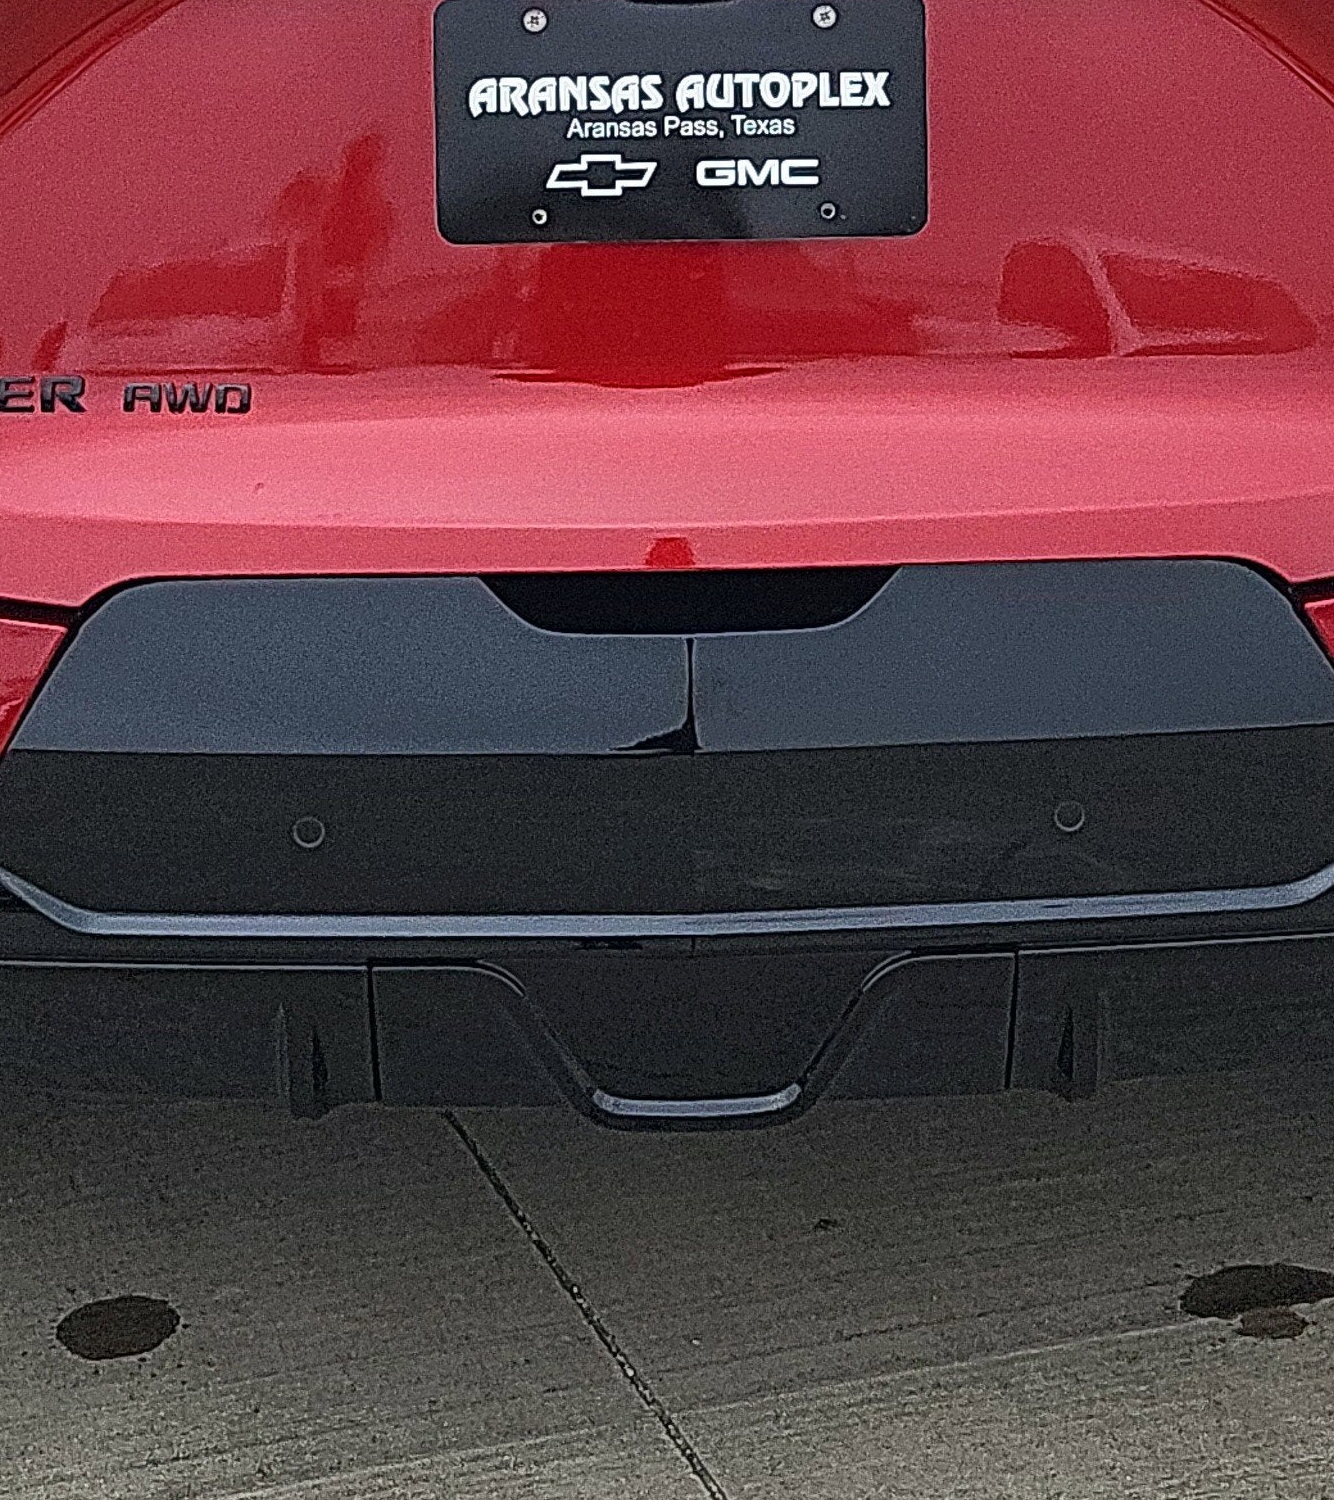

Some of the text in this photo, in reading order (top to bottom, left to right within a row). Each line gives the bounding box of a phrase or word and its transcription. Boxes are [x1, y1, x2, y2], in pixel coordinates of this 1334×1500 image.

[468, 71, 892, 117] ARANSAS AUTOPLEX
[566, 114, 795, 140] Aransas Pass, Texas
[695, 158, 820, 187] GMC
[122, 381, 253, 414] AWD
